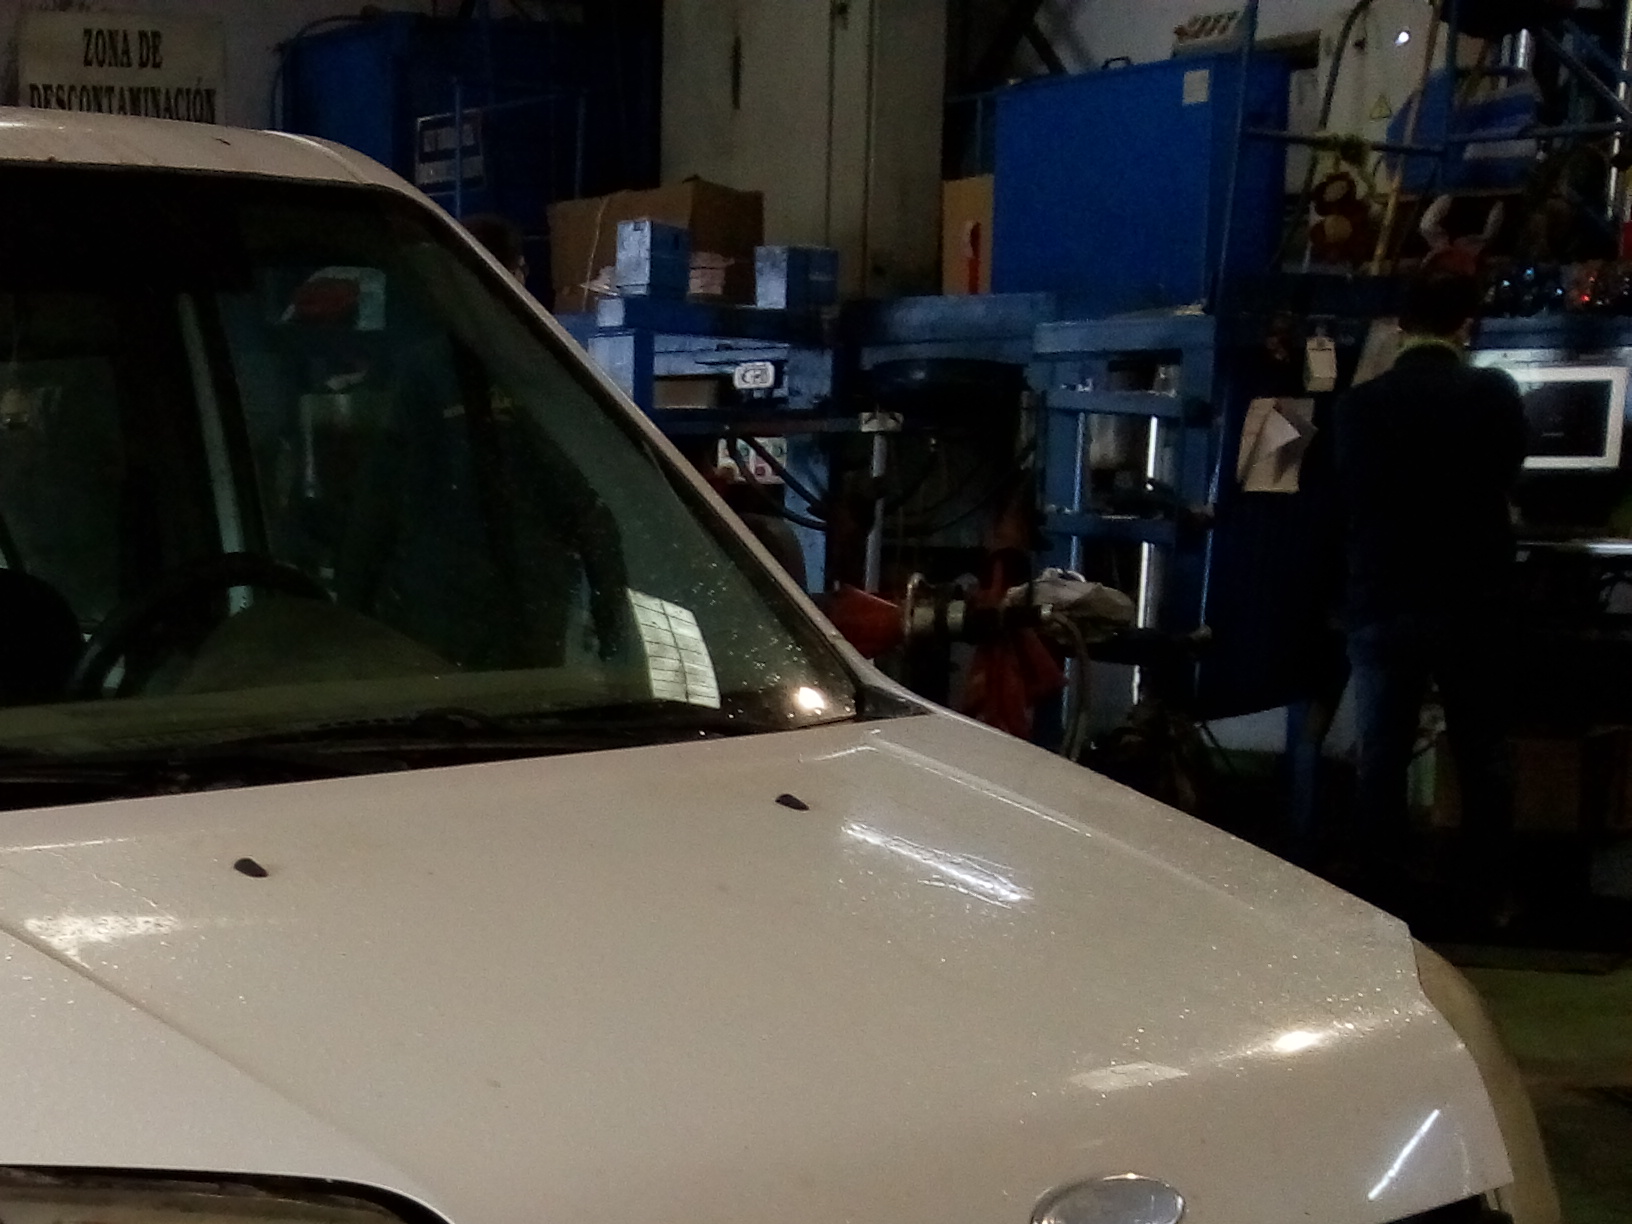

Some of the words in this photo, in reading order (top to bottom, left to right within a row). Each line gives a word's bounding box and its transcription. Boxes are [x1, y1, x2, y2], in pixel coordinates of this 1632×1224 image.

[82, 27, 132, 68] ZONA
[137, 29, 164, 69] DE
[28, 75, 218, 124] DESCONTAMINACIÓN
